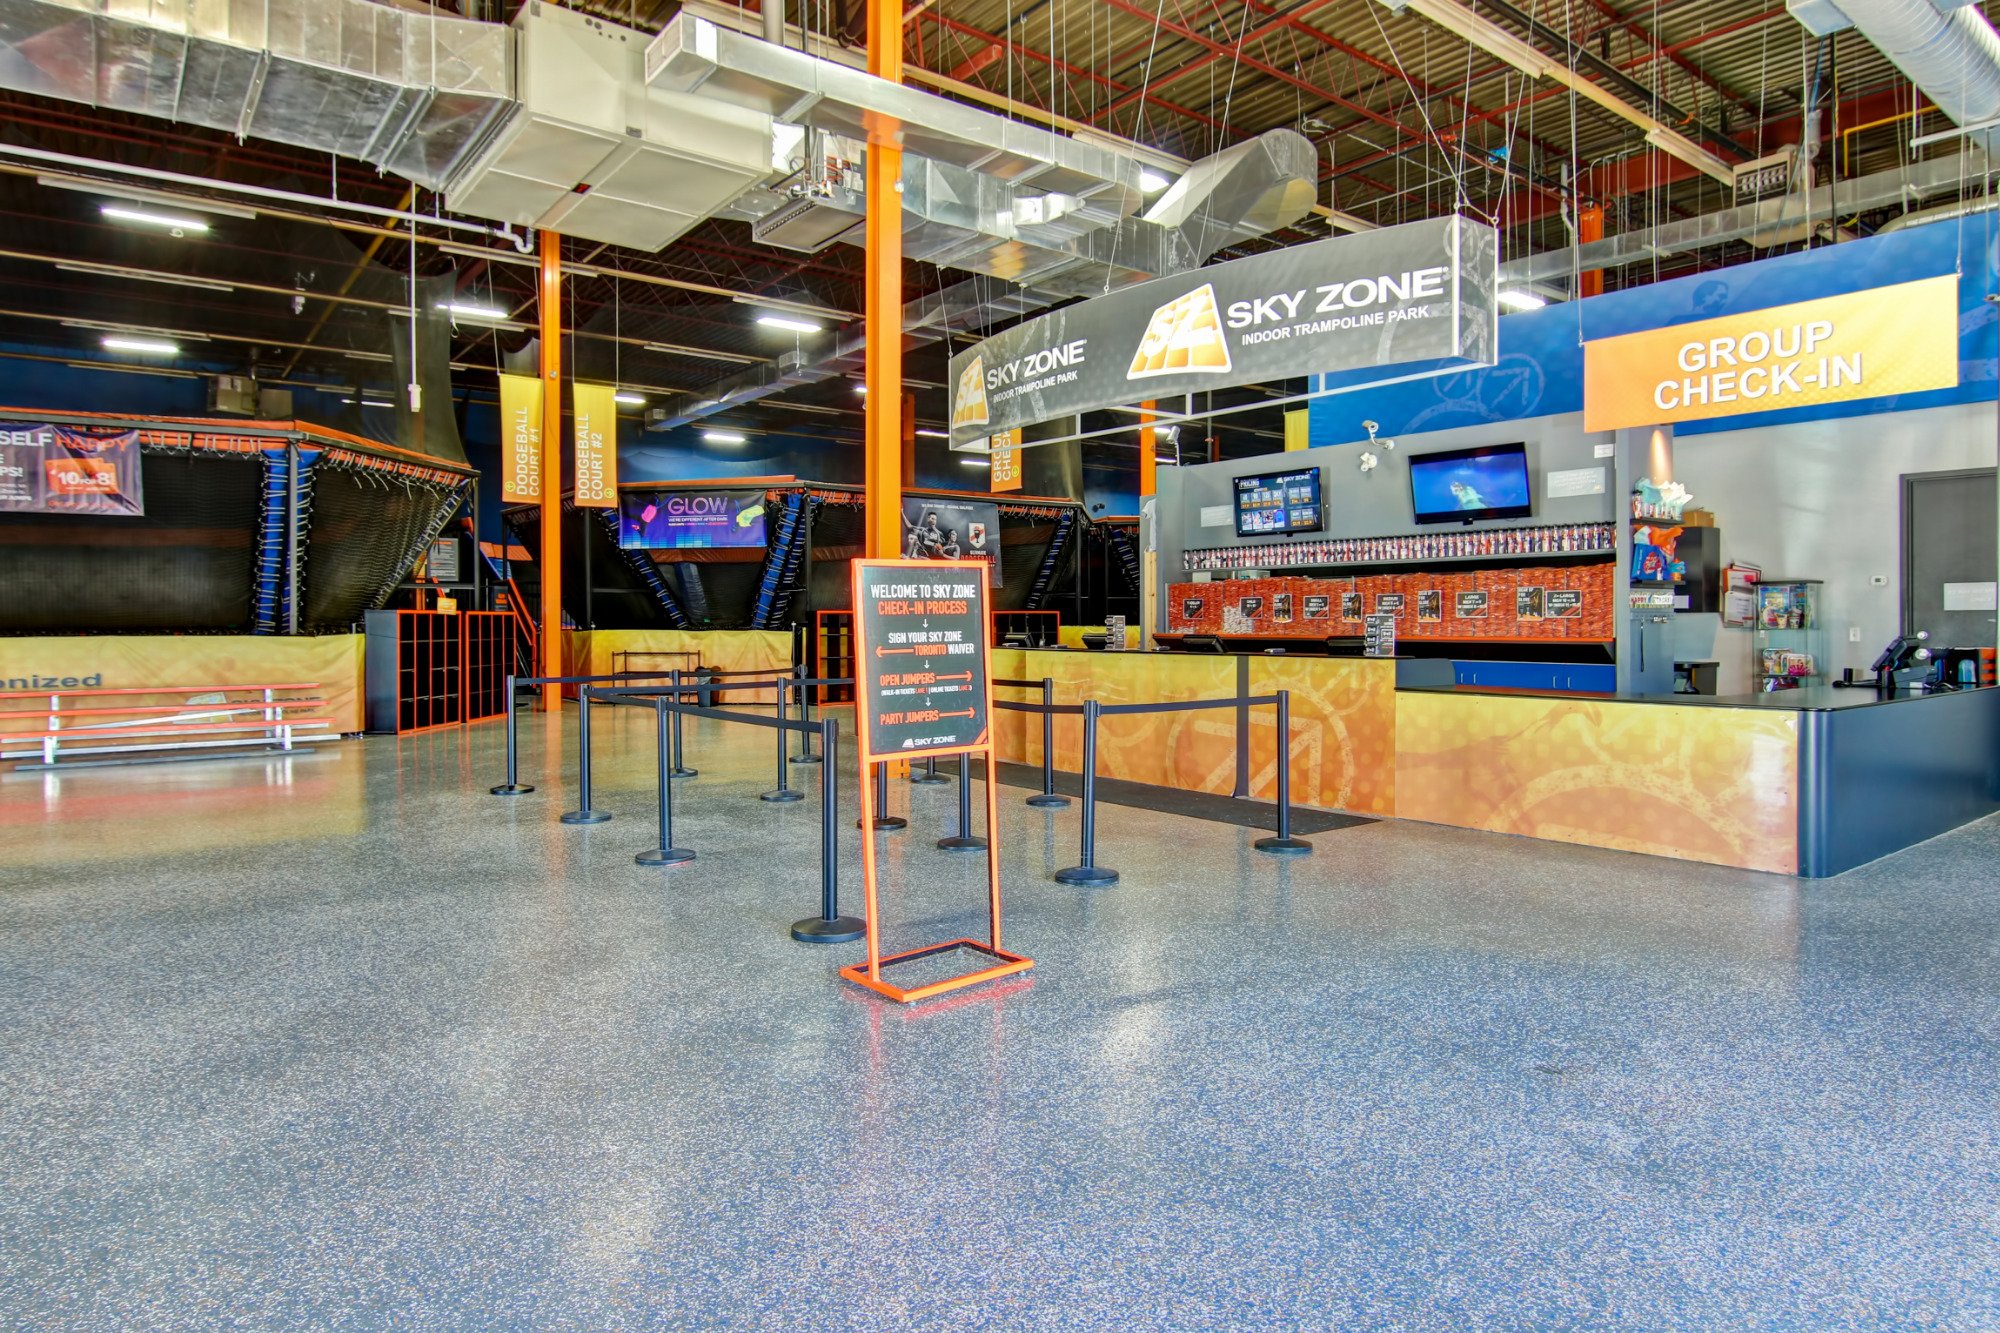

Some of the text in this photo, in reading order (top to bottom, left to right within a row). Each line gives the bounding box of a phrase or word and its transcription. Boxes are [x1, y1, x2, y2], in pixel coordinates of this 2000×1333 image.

[1227, 266, 1444, 328] SKY ZONE
[1242, 305, 1429, 346] INDOOR TRAMPOLINE PARK
[1678, 320, 1833, 372] GROUP
[987, 339, 1085, 390] SKY ZONE
[993, 370, 1078, 403] INDOOR TRAMPOLINE PARK
[1653, 352, 1862, 411] CHECK-IN
[516, 406, 528, 495] DODGEBALL
[529, 428, 539, 496] COURT #1
[577, 413, 590, 499] DODGEBALL
[591, 432, 603, 499] COURT #2
[58, 471, 80, 485] 10
[667, 497, 728, 515] GLOW
[870, 584, 976, 599] WELCOME TO SKY ZONE
[878, 600, 967, 615] CHECK-IN PROCESS
[888, 631, 962, 644] SIGN YOUR SKY ZONE
[914, 643, 975, 656] TORONTO WAIVER
[880, 672, 936, 686] OPEN JUMPERS
[880, 710, 939, 725] PARTY JUMPERS
[914, 735, 956, 746] SKY ZONE
